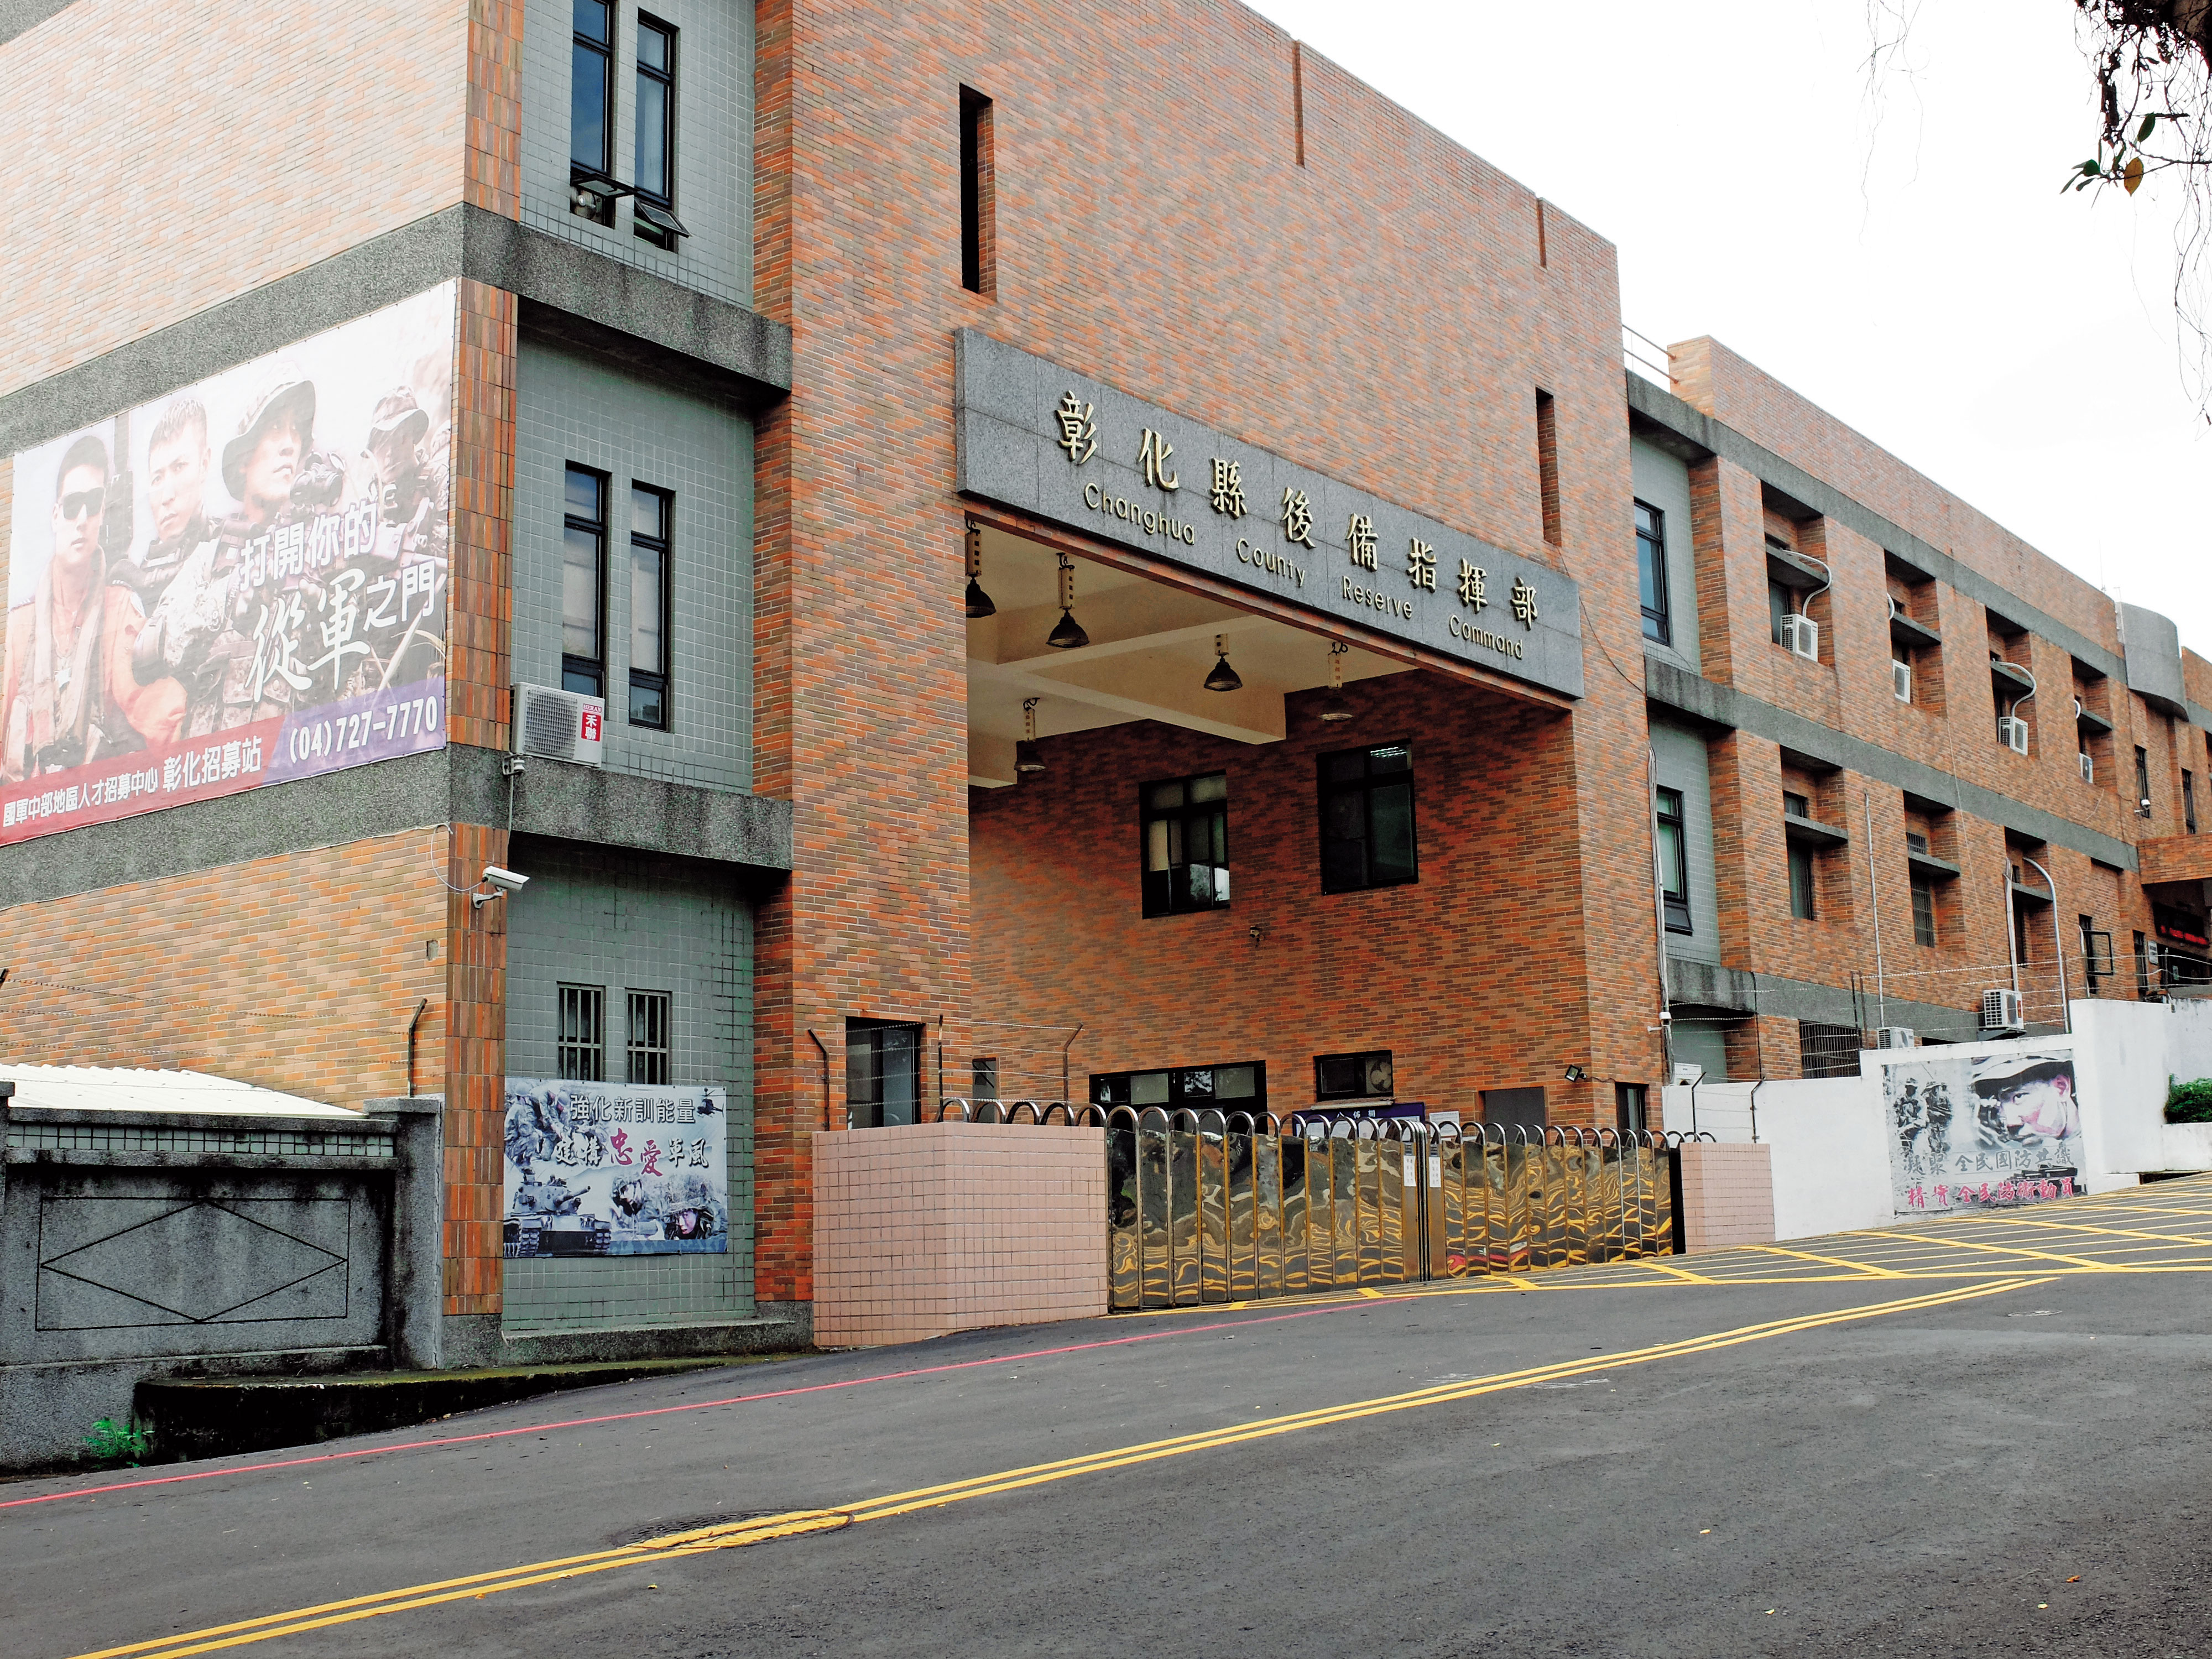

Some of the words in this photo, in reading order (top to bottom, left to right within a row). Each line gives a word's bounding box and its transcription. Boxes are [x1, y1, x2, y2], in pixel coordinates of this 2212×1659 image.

[239, 498, 378, 591] 打開你的
[1055, 390, 1538, 632] 彰化縣後備指揮部
[1084, 482, 1196, 545] Changhua
[1237, 538, 1306, 588] County
[1342, 576, 1413, 619] Reserve
[1449, 614, 1524, 660] Command
[244, 560, 436, 703] 從軍之門
[289, 696, 438, 764] (04)727-7770
[583, 704, 602, 712] HERAN
[585, 714, 597, 740] 禾聯
[2, 766, 159, 828] 國軍中部地區人才招募中心
[162, 735, 263, 792] 彰化招募站
[570, 1094, 696, 1124] 強化新訓能量
